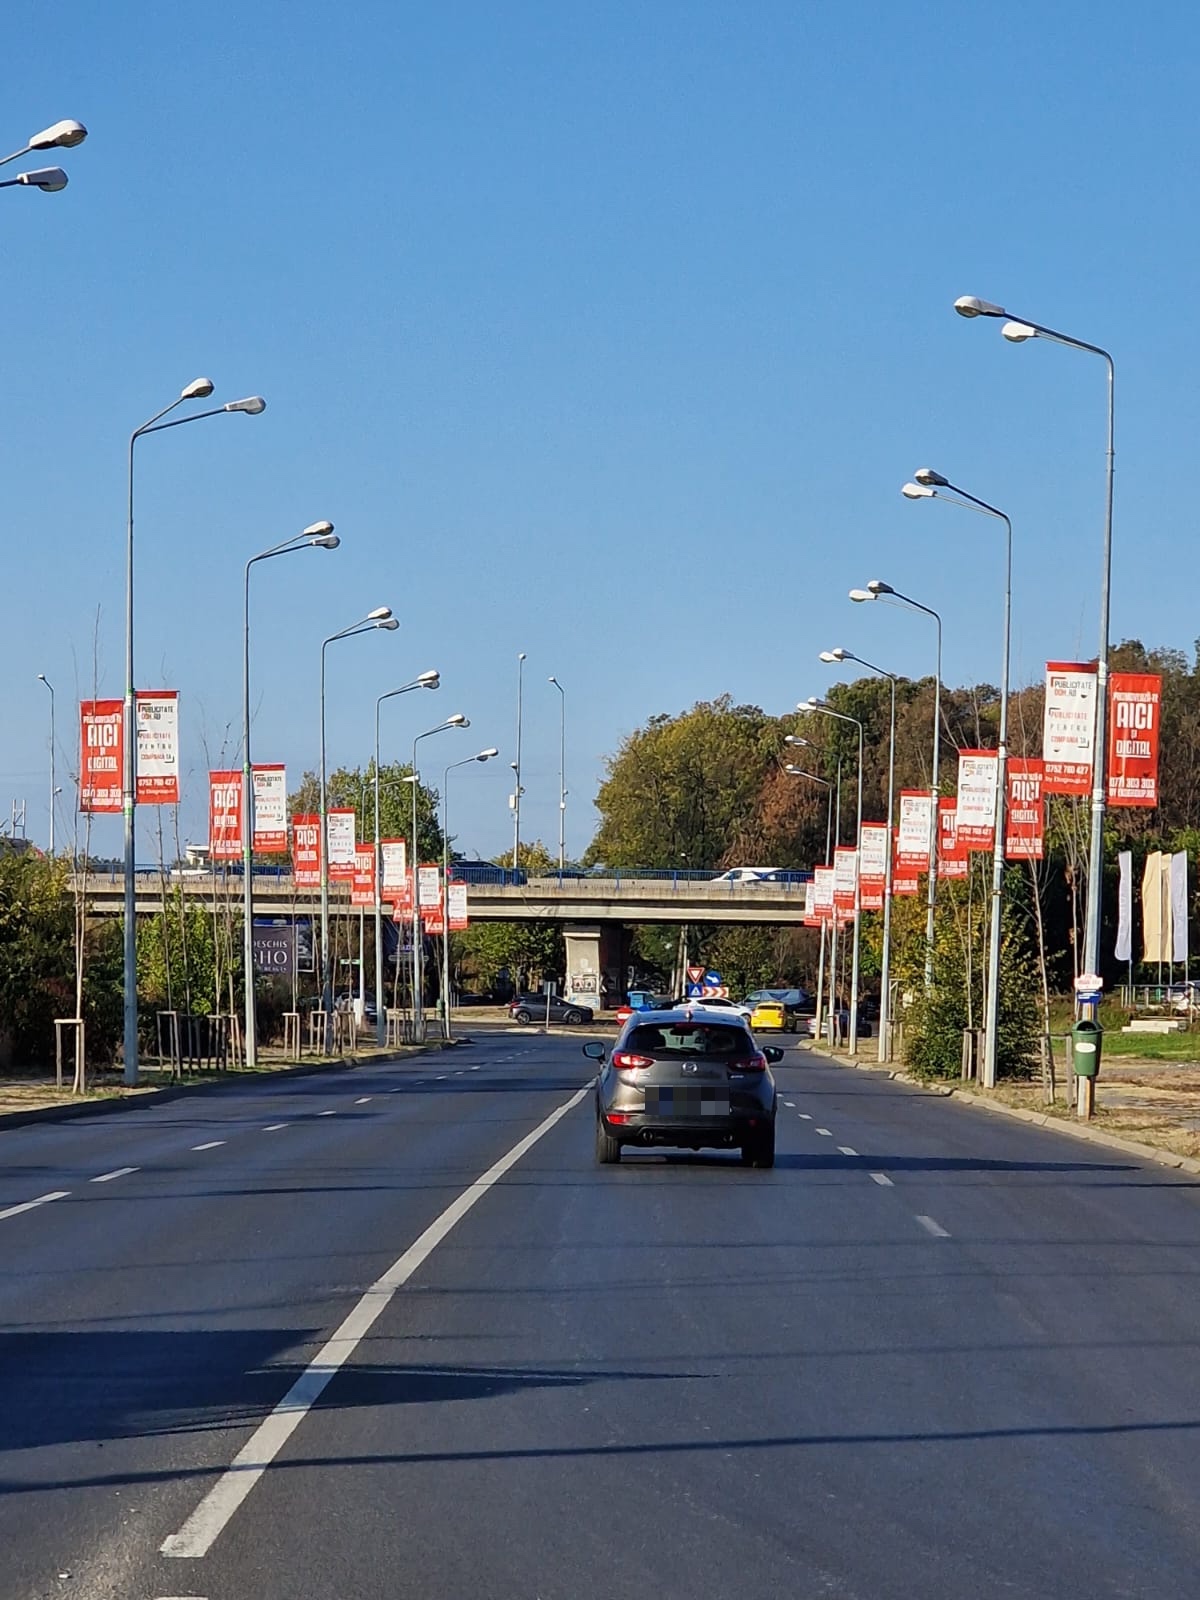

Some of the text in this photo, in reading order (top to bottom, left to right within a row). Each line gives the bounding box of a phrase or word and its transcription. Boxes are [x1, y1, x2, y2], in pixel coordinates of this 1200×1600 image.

[1054, 680, 1092, 689] PUBLICITATE
[141, 705, 173, 713] PUBLICITATE
[1117, 702, 1153, 729] AICI
[88, 724, 118, 747] AICI
[1116, 740, 1151, 756] DIGITAL
[214, 790, 238, 808] AICI
[1012, 781, 1039, 800] AICI
